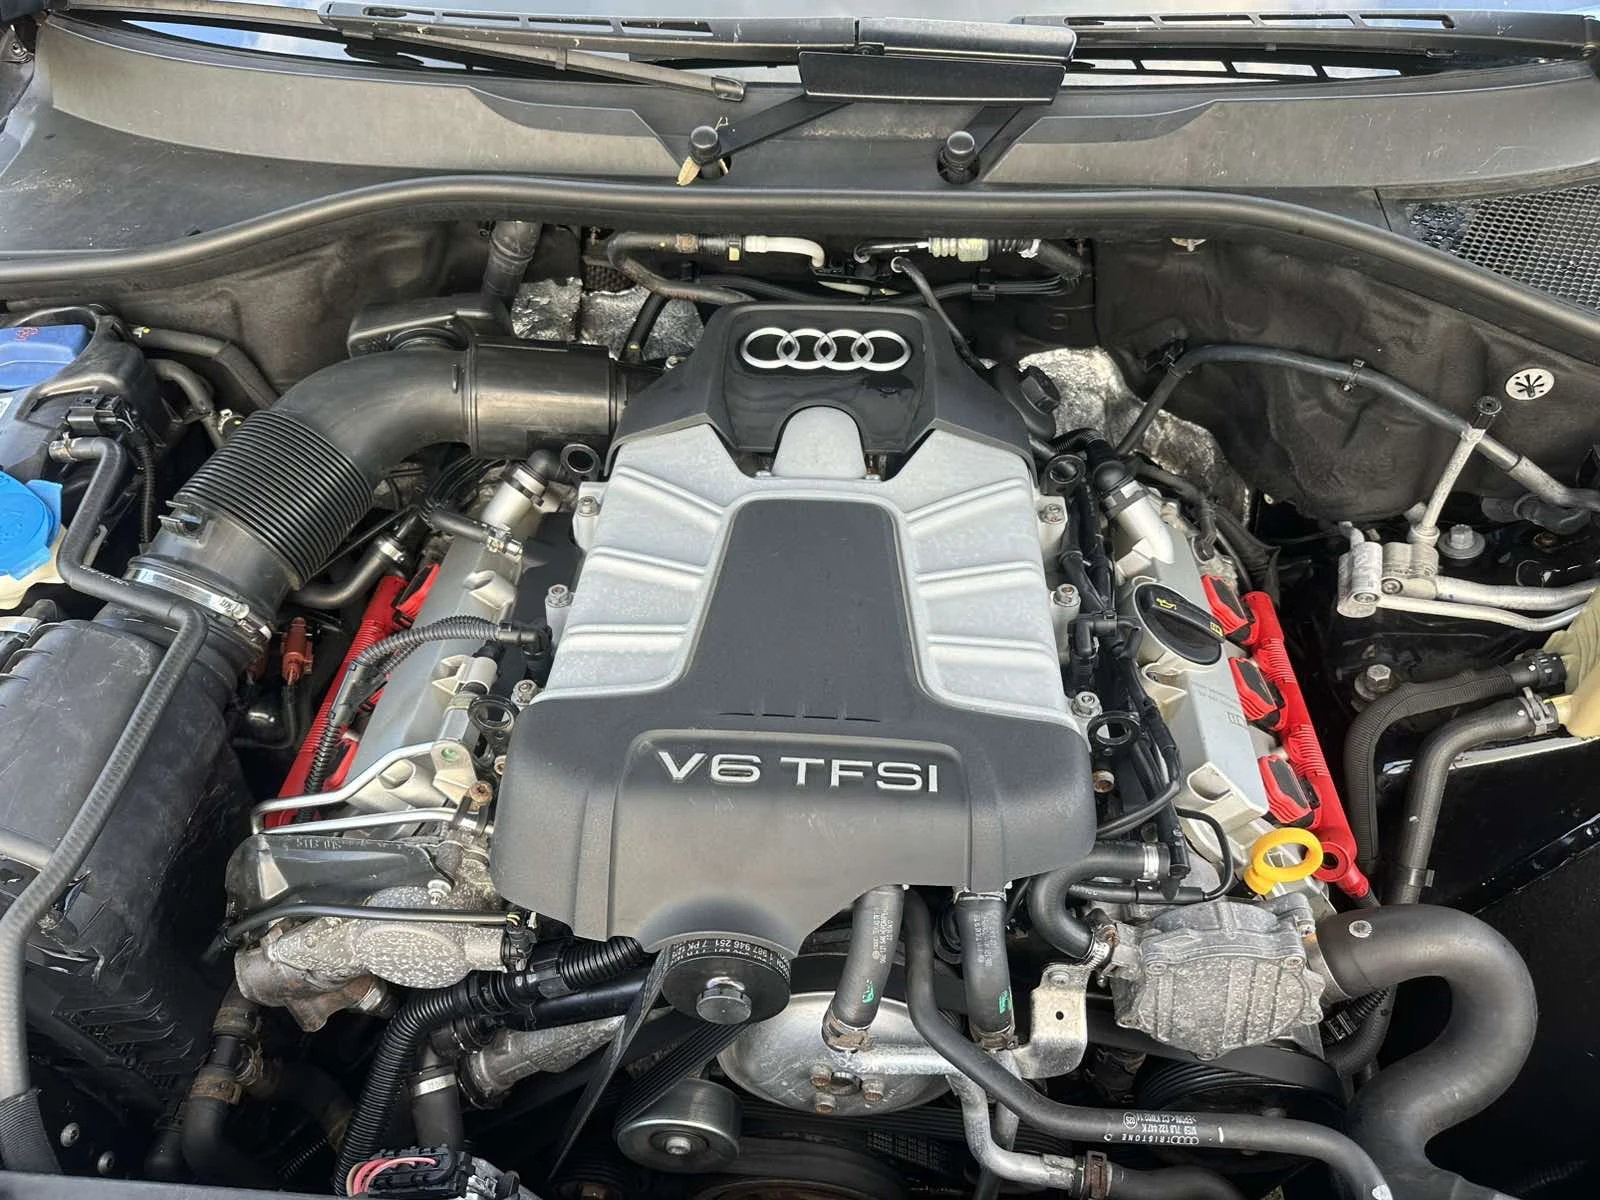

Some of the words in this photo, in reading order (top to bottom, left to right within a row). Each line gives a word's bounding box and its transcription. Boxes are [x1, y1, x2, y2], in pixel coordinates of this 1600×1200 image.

[658, 751, 761, 783] V6
[780, 756, 938, 793] TFSI
[701, 939, 708, 948] 7
[714, 939, 732, 947] 251
[733, 941, 751, 951] 946
[752, 947, 768, 958] 987
[1121, 1134, 1171, 1143] TRISTONE
